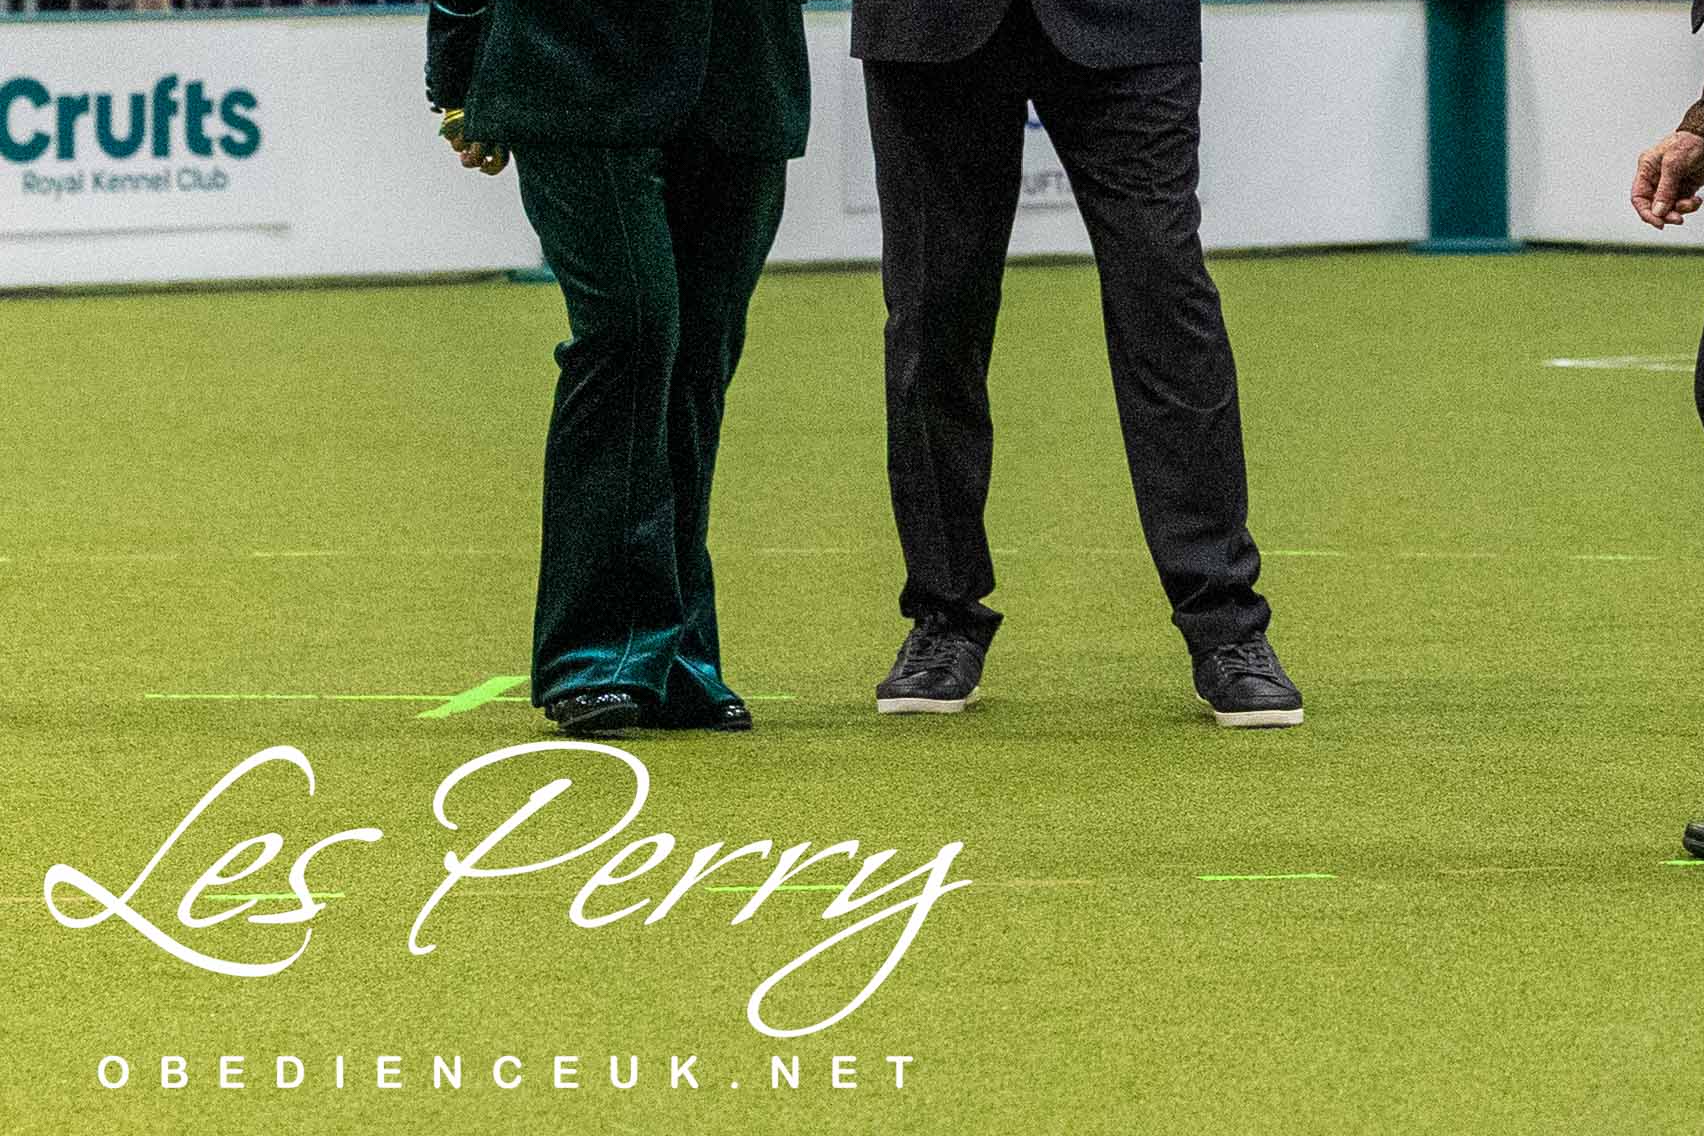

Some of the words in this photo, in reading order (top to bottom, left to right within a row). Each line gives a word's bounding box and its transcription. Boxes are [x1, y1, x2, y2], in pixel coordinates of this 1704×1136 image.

[0, 73, 263, 163] Crufts
[21, 169, 84, 200] Royal
[92, 168, 170, 193] Kennel
[175, 165, 229, 192] Club
